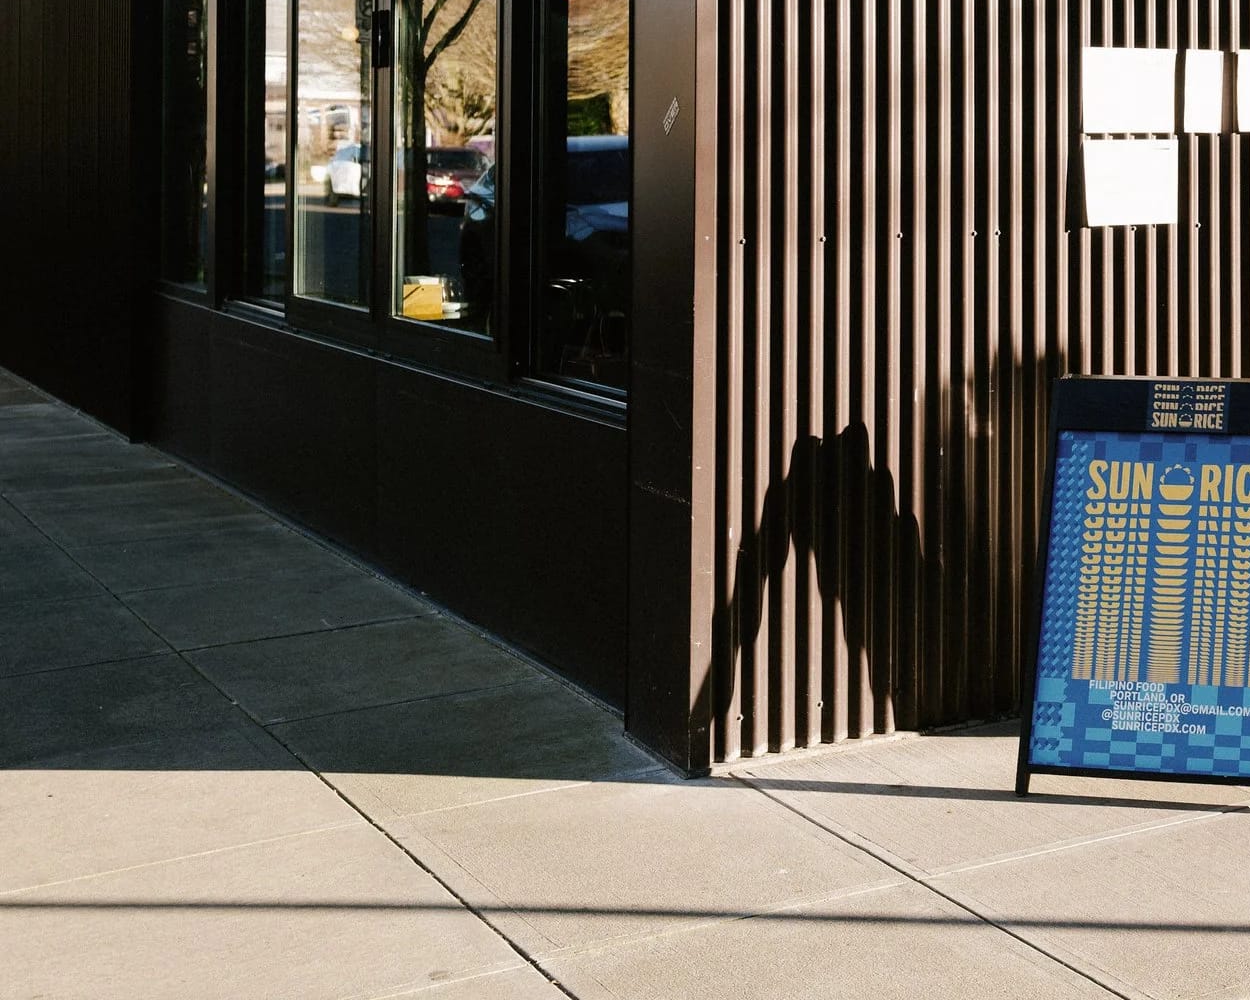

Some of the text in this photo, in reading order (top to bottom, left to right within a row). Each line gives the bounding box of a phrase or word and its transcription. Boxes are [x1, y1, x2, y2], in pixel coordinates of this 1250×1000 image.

[1151, 412, 1224, 430] SUN RICE
[1086, 460, 1155, 500] SUN
[1089, 679, 1165, 692] FILIPINO FOOD
[1110, 690, 1186, 704] PORTLAND, OR
[1101, 709, 1181, 723] @SUNRICEPDX
[1111, 720, 1207, 735] SUNRICEPDX.COM
